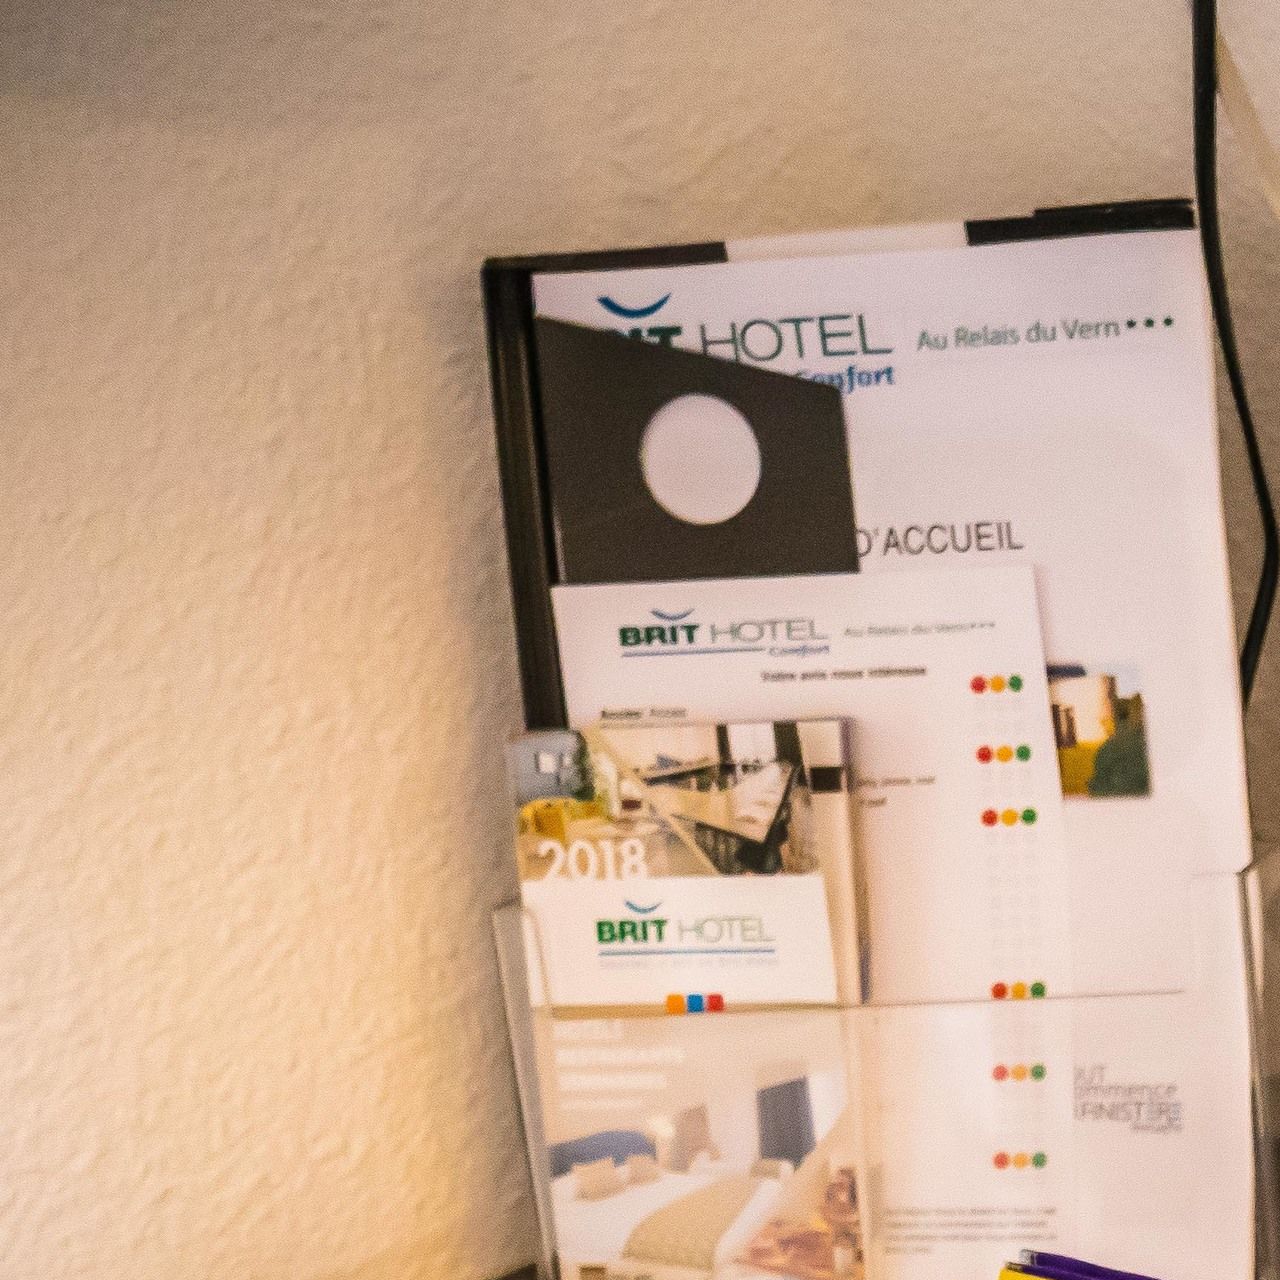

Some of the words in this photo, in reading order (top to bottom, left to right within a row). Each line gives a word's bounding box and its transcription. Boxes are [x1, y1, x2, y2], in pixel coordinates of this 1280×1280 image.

[699, 314, 894, 364] HOTEL
[916, 328, 949, 352] Au
[953, 322, 1021, 349] Relais
[1025, 318, 1057, 345] du
[1060, 317, 1122, 341] Vern
[619, 623, 699, 647] BRIT
[710, 616, 829, 644] HOTEL
[537, 838, 648, 881] 2018
[595, 917, 668, 944] BRIT
[677, 914, 777, 943] HOTEL
